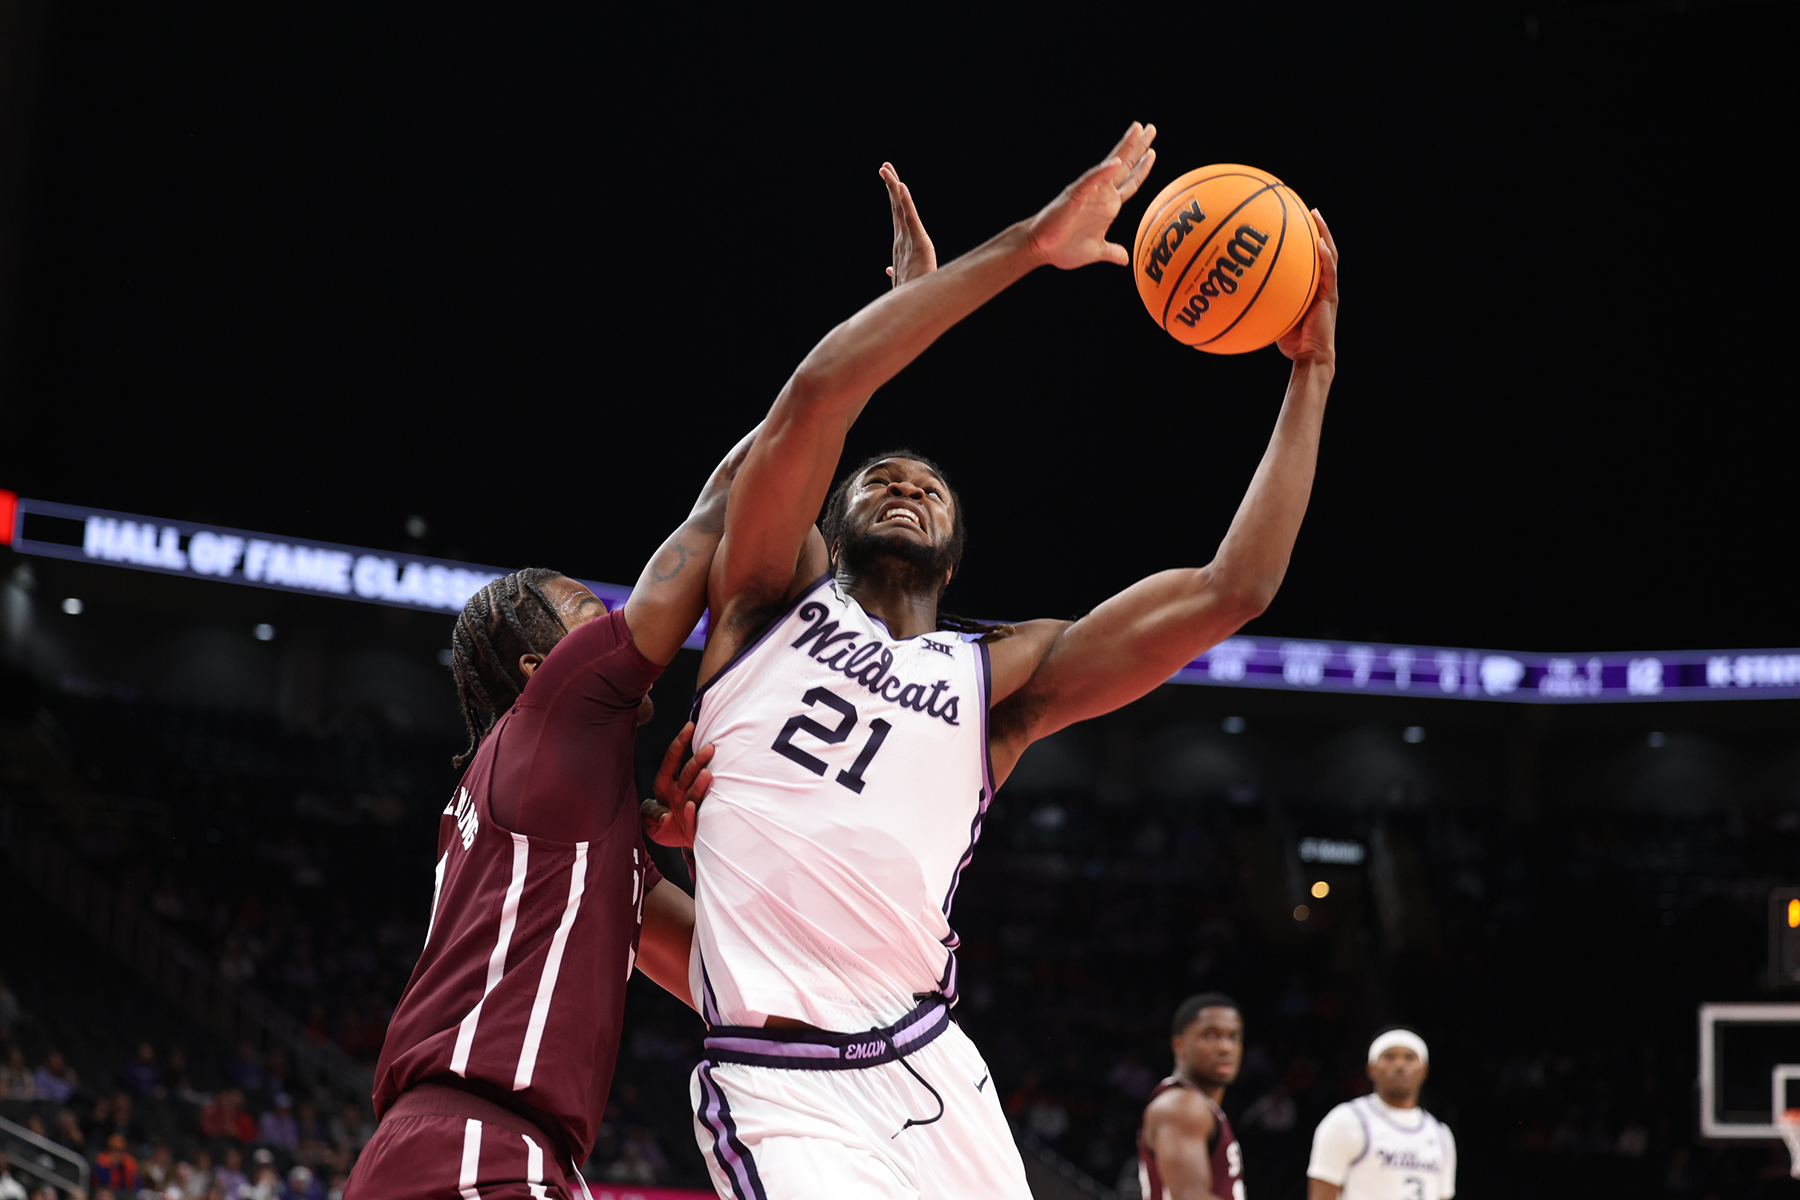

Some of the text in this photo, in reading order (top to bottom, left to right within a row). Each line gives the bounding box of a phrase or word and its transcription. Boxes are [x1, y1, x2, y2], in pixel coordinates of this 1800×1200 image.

[1145, 199, 1206, 285] NCAA
[1174, 224, 1271, 328] Wilson
[83, 515, 188, 571] HALL
[188, 530, 244, 577] OF
[244, 539, 354, 595] FAME
[790, 601, 961, 727] Wildcats
[770, 686, 893, 795] 21
[844, 1040, 887, 1060] EMAW
